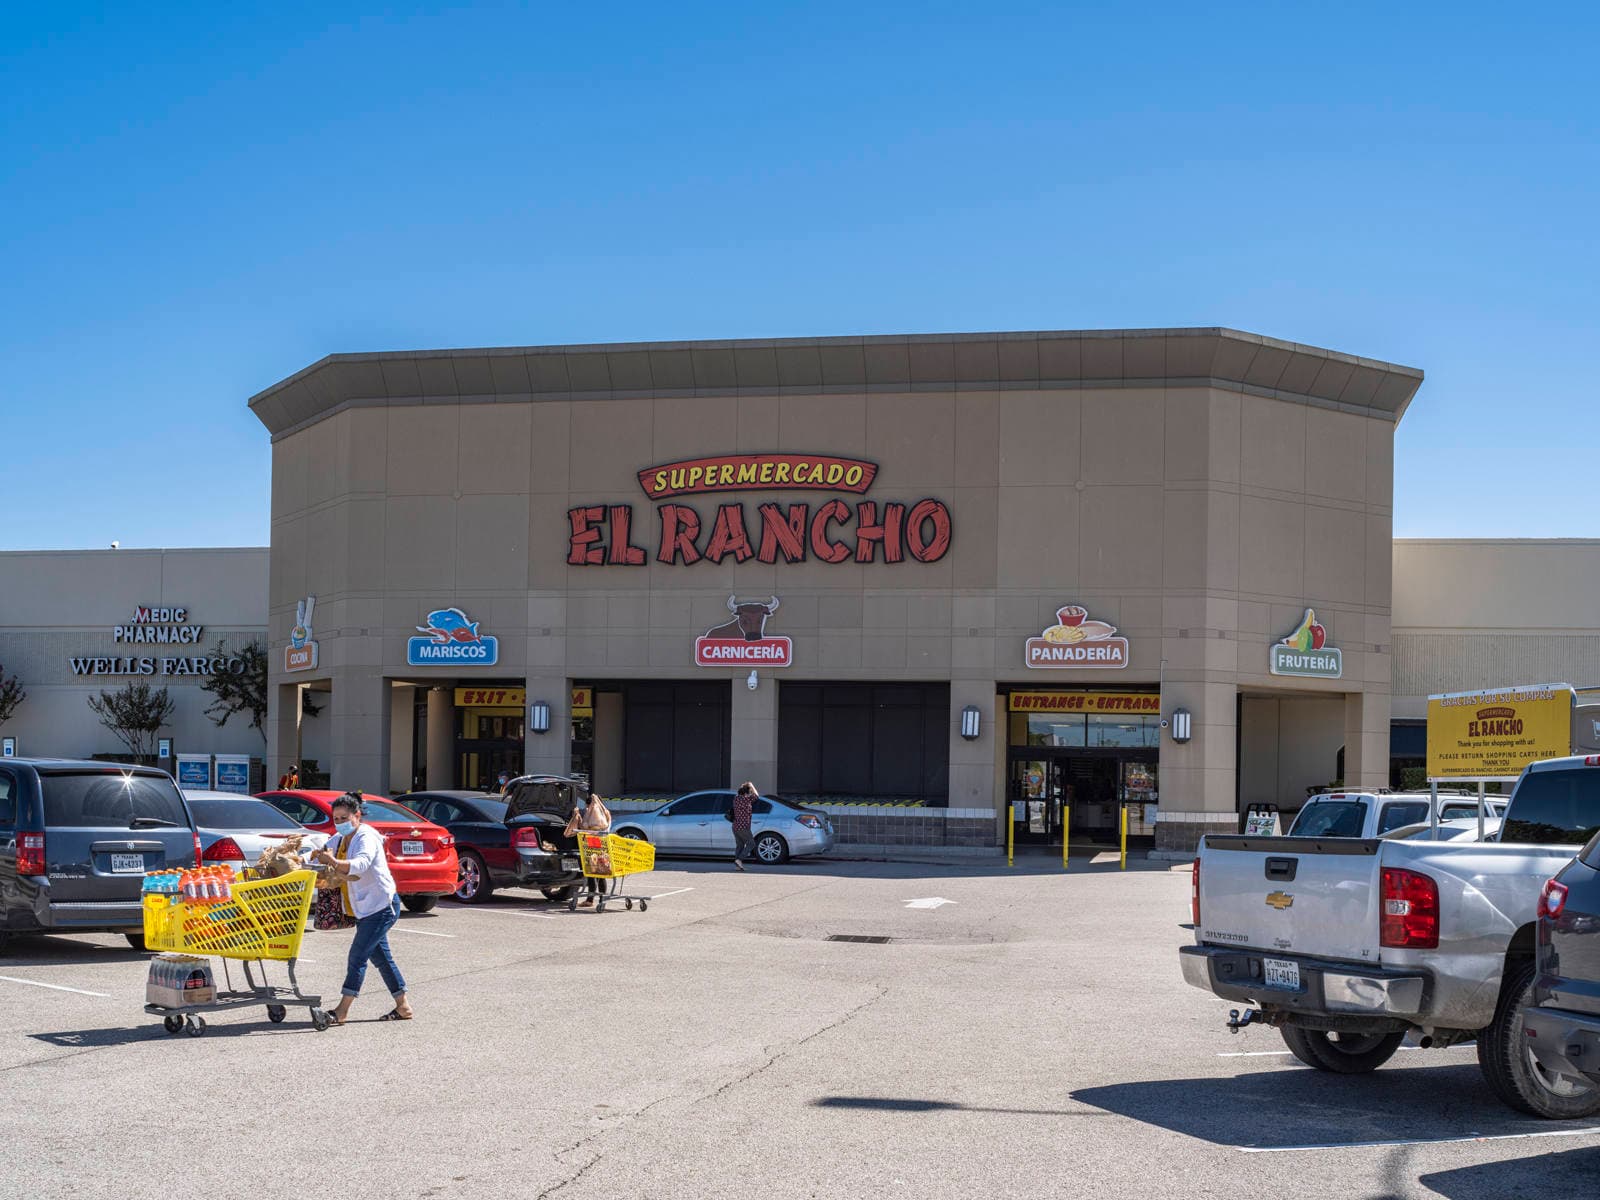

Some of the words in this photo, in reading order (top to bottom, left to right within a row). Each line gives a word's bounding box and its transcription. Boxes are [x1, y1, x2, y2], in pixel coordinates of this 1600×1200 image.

[654, 462, 864, 492] SUPERMERCADO
[566, 504, 647, 566] EL
[656, 499, 953, 566] RANCHO
[131, 605, 185, 623] MEDIC
[113, 626, 201, 643] PHARMACY
[419, 645, 487, 659] MARISCOS
[702, 642, 785, 660] CARNICERÍA
[1031, 644, 1122, 661] PANADERÍA
[69, 657, 154, 675] WELLS
[160, 658, 246, 675] FARGO
[1278, 653, 1338, 672] FRUTERÍA
[463, 690, 506, 704] EXIT
[1013, 695, 1085, 709] ENTRANCE
[1096, 696, 1160, 710] ENTRADA
[1479, 694, 1497, 704] POR
[1500, 693, 1511, 703] SU
[1468, 721, 1480, 737] EL
[1482, 719, 1523, 737] RANCHO
[1472, 741, 1482, 749] you
[1491, 739, 1514, 748] shopping
[1515, 738, 1527, 746] with
[1273, 960, 1289, 968] TEXAS
